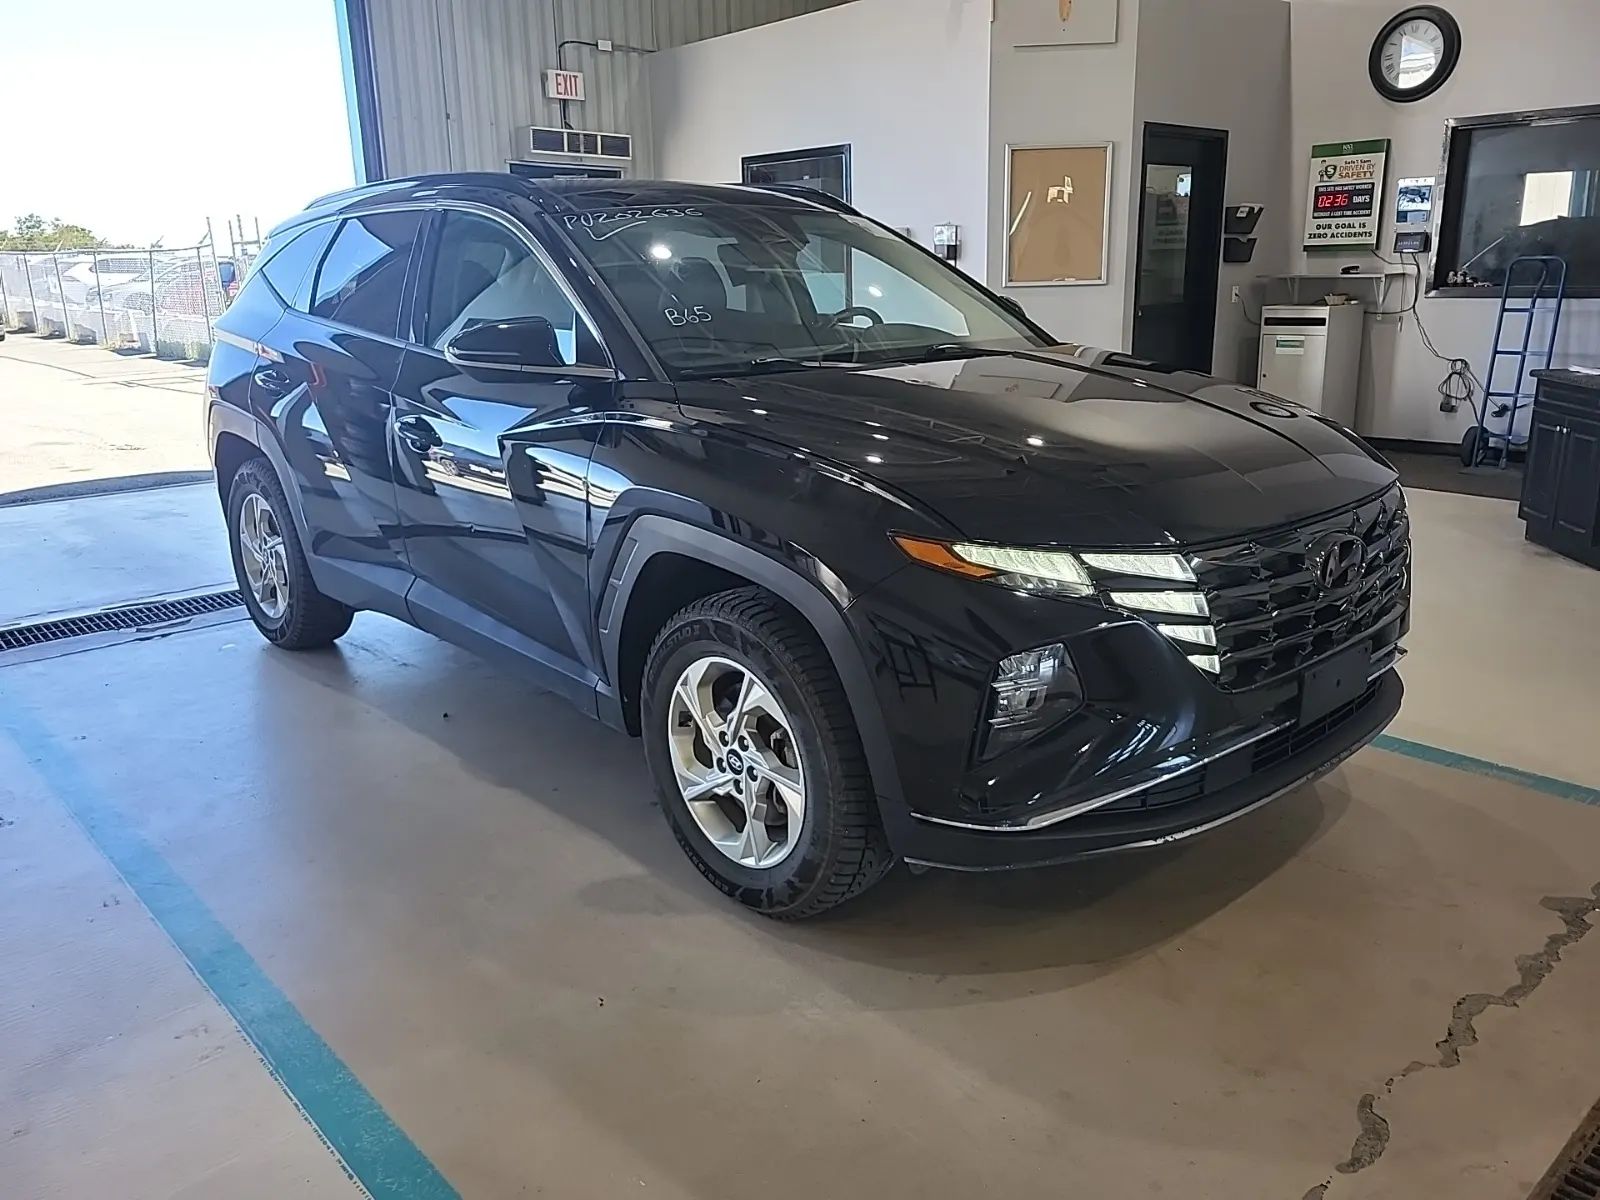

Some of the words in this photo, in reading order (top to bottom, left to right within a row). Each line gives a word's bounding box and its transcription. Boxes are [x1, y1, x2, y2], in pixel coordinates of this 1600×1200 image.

[555, 73, 578, 97] EXIT
[1339, 164, 1365, 172] DRIVEN
[1366, 163, 1376, 171] BY
[1338, 170, 1374, 178] SAFETY
[1352, 195, 1370, 203] DAYS
[1330, 231, 1372, 239] ACCIDENTS
[664, 306, 712, 326] B65
